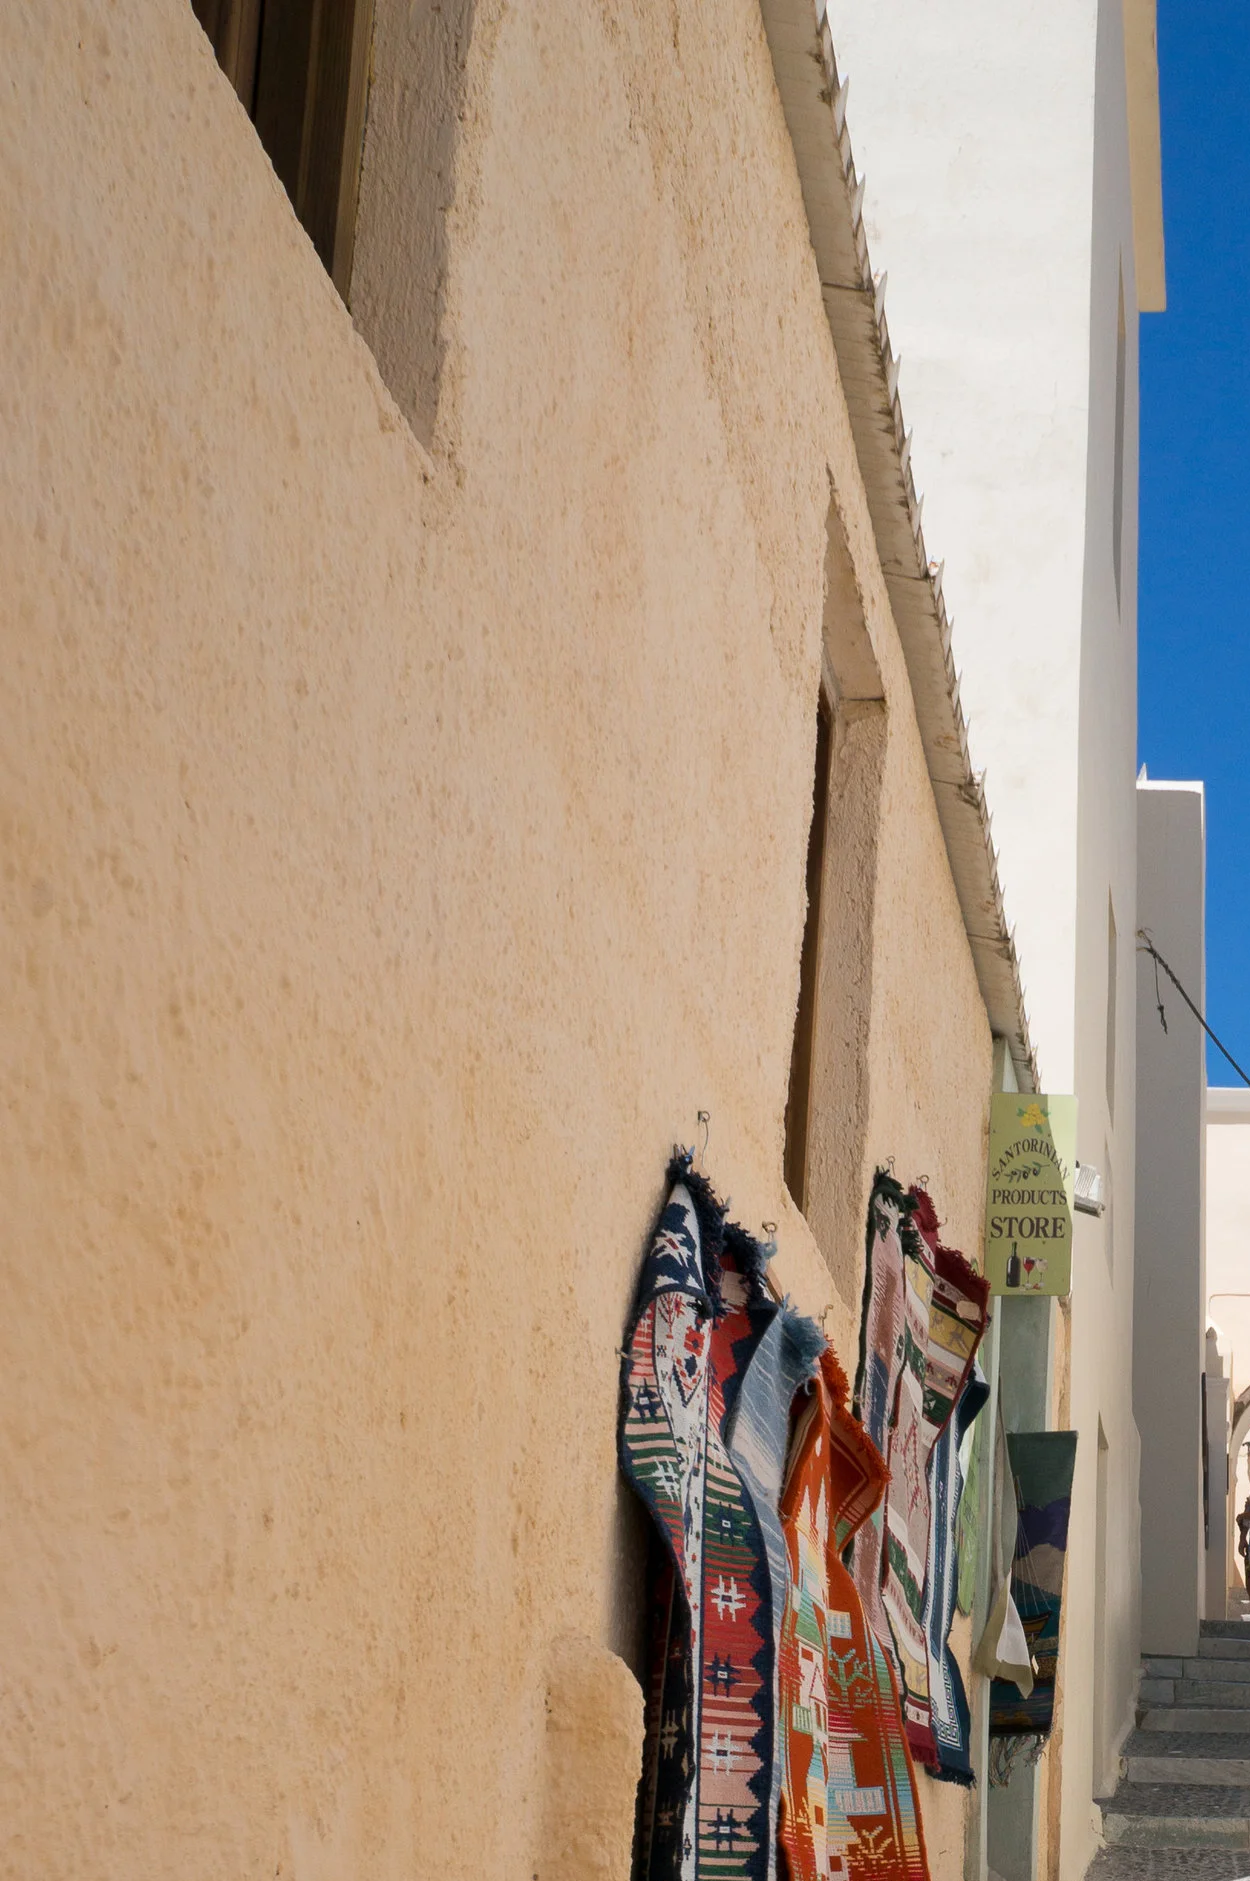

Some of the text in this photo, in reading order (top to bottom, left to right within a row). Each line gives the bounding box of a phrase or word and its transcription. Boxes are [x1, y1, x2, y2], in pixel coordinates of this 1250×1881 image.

[992, 1139, 1070, 1181] SANTORINIAN
[992, 1189, 1067, 1205] PRODUCTS
[991, 1216, 1065, 1238] STORE
